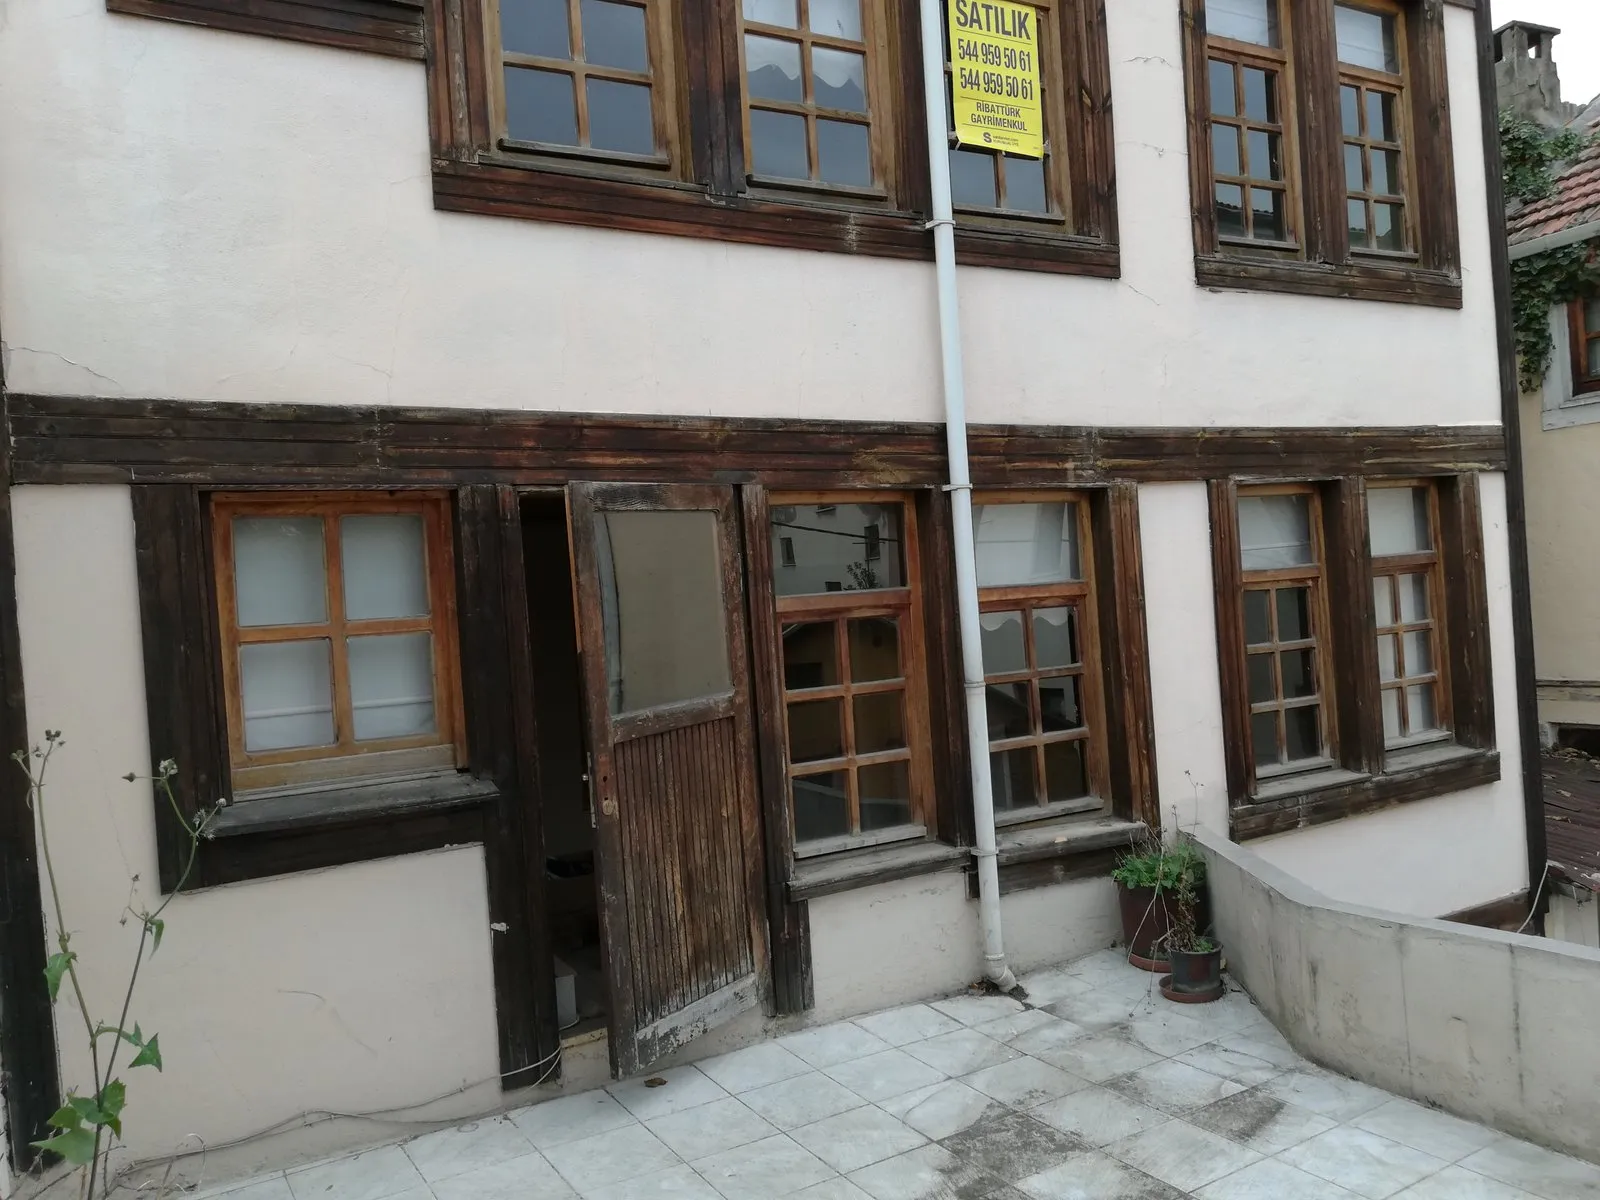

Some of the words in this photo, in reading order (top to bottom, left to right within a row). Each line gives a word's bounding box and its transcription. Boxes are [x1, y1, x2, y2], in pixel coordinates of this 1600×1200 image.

[956, 0, 1031, 40] SATILIK
[958, 38, 979, 62] 544
[981, 43, 1001, 67] 959
[1004, 47, 1017, 70] 50
[1019, 50, 1032, 72] 61
[960, 67, 980, 91] 544
[983, 71, 1003, 95] 959
[1005, 75, 1019, 98] 50
[1021, 78, 1033, 100] 61
[971, 113, 1027, 131] GAYRİMENKUL
